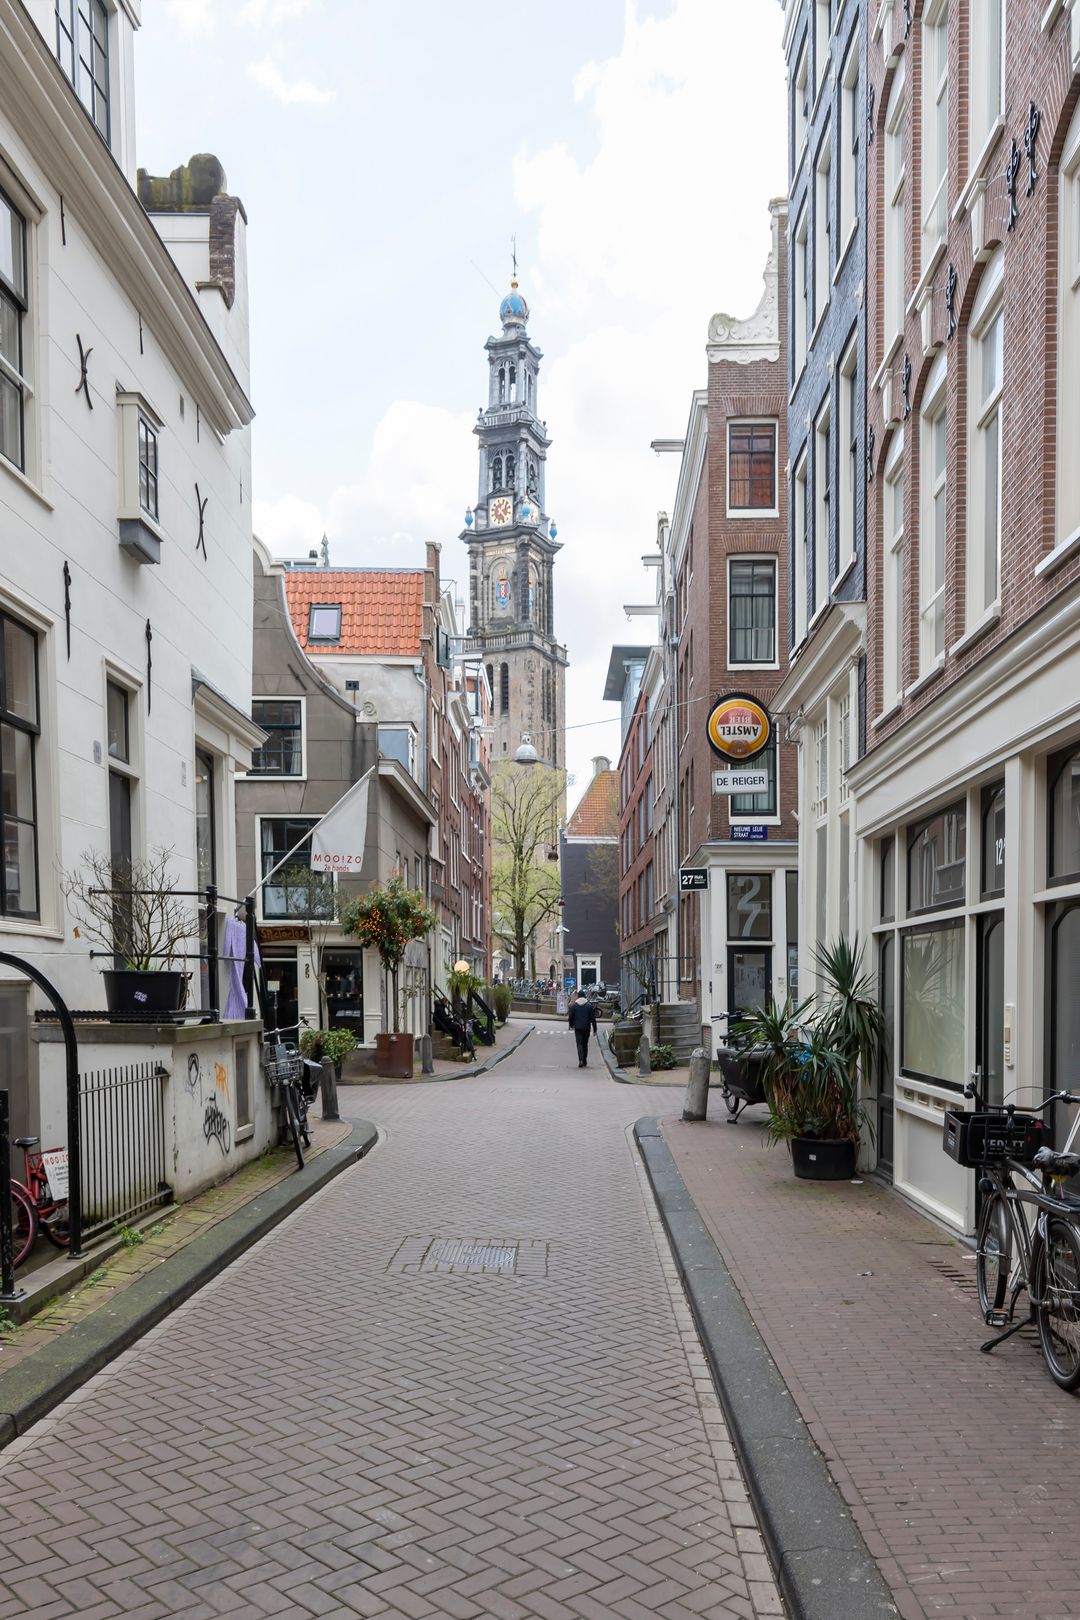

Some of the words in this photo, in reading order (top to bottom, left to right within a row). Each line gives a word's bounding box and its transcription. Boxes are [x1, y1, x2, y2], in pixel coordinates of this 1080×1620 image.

[729, 715, 751, 724] BIER
[720, 725, 759, 737] AMSTEL
[716, 777, 729, 786] DE
[732, 776, 765, 786] REIGER
[682, 875, 694, 885] 27
